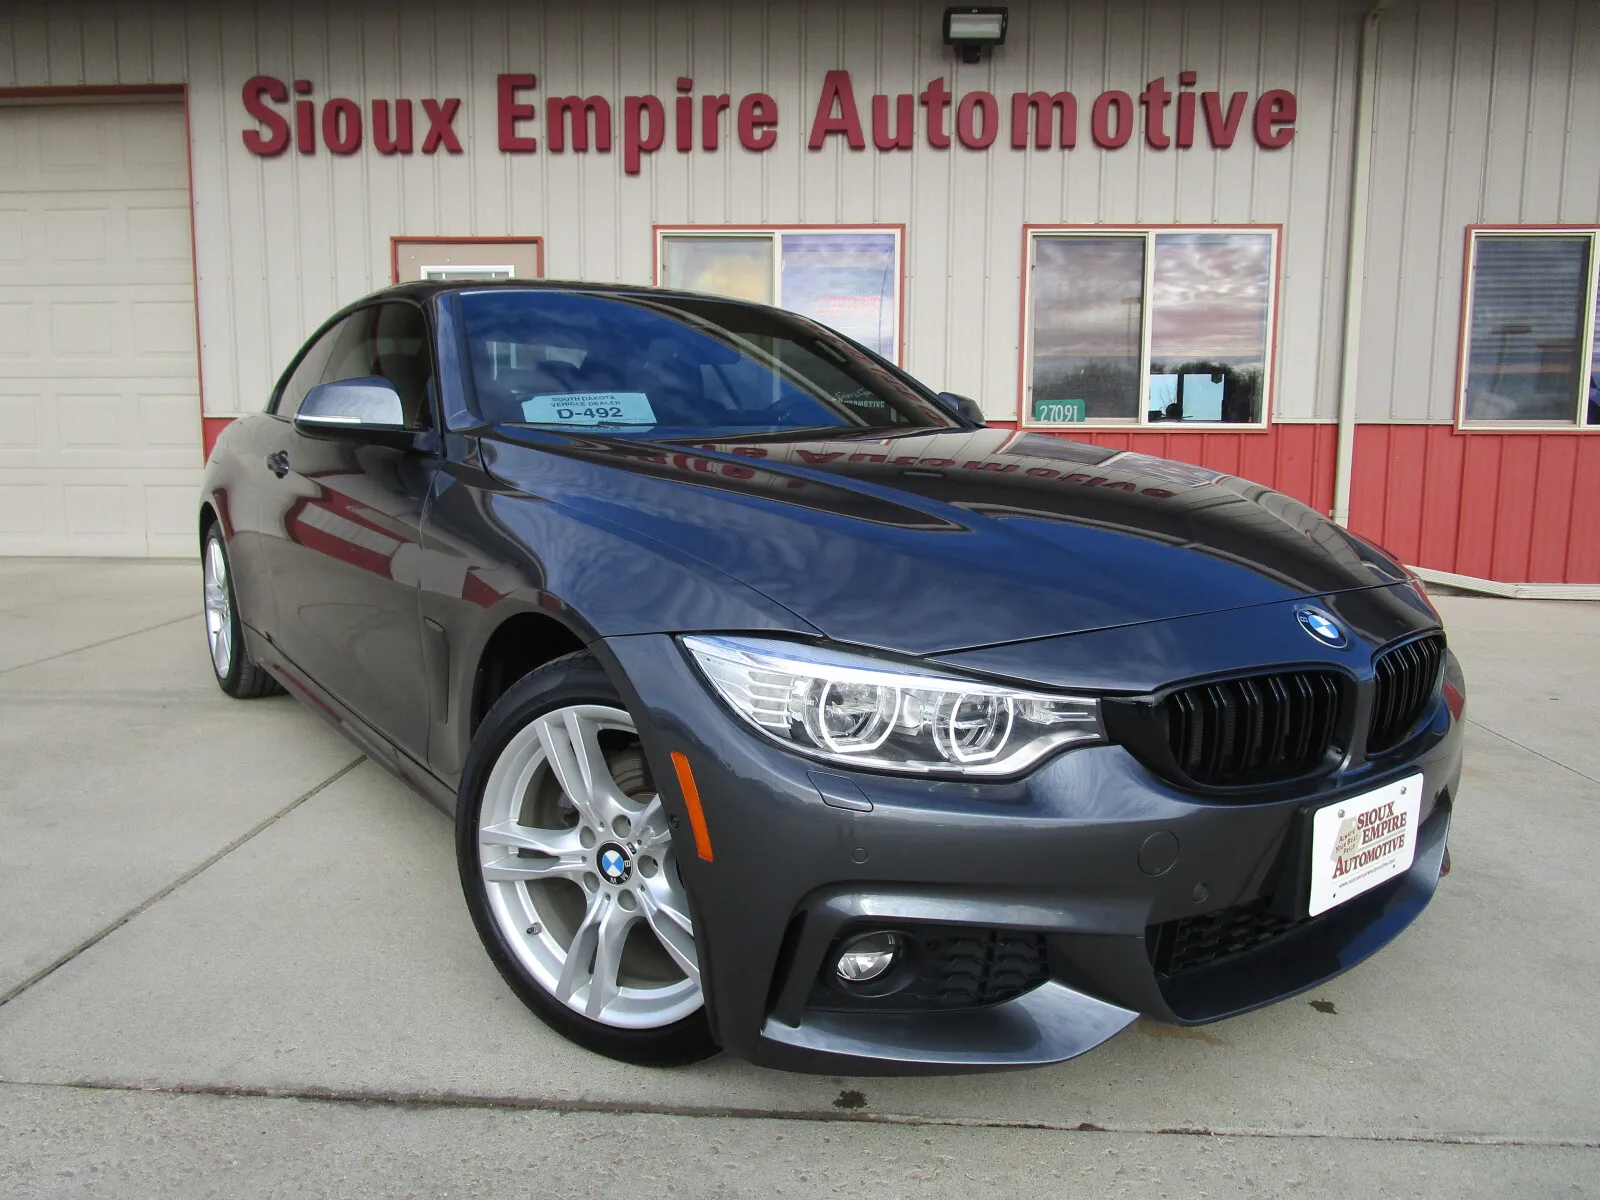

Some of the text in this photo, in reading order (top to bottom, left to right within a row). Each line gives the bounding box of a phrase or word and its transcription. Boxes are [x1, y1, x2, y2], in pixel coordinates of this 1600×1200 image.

[241, 70, 1298, 175] Sioux Empire Automotive
[816, 295, 881, 316] OPEN
[556, 406, 624, 419] D-492
[1040, 404, 1078, 423] 27091
[1356, 800, 1396, 830] SIOUX
[1361, 811, 1407, 845] EMPIRE
[1332, 834, 1405, 879] AUTOMOTIVE
[610, 859, 631, 885] BMW
